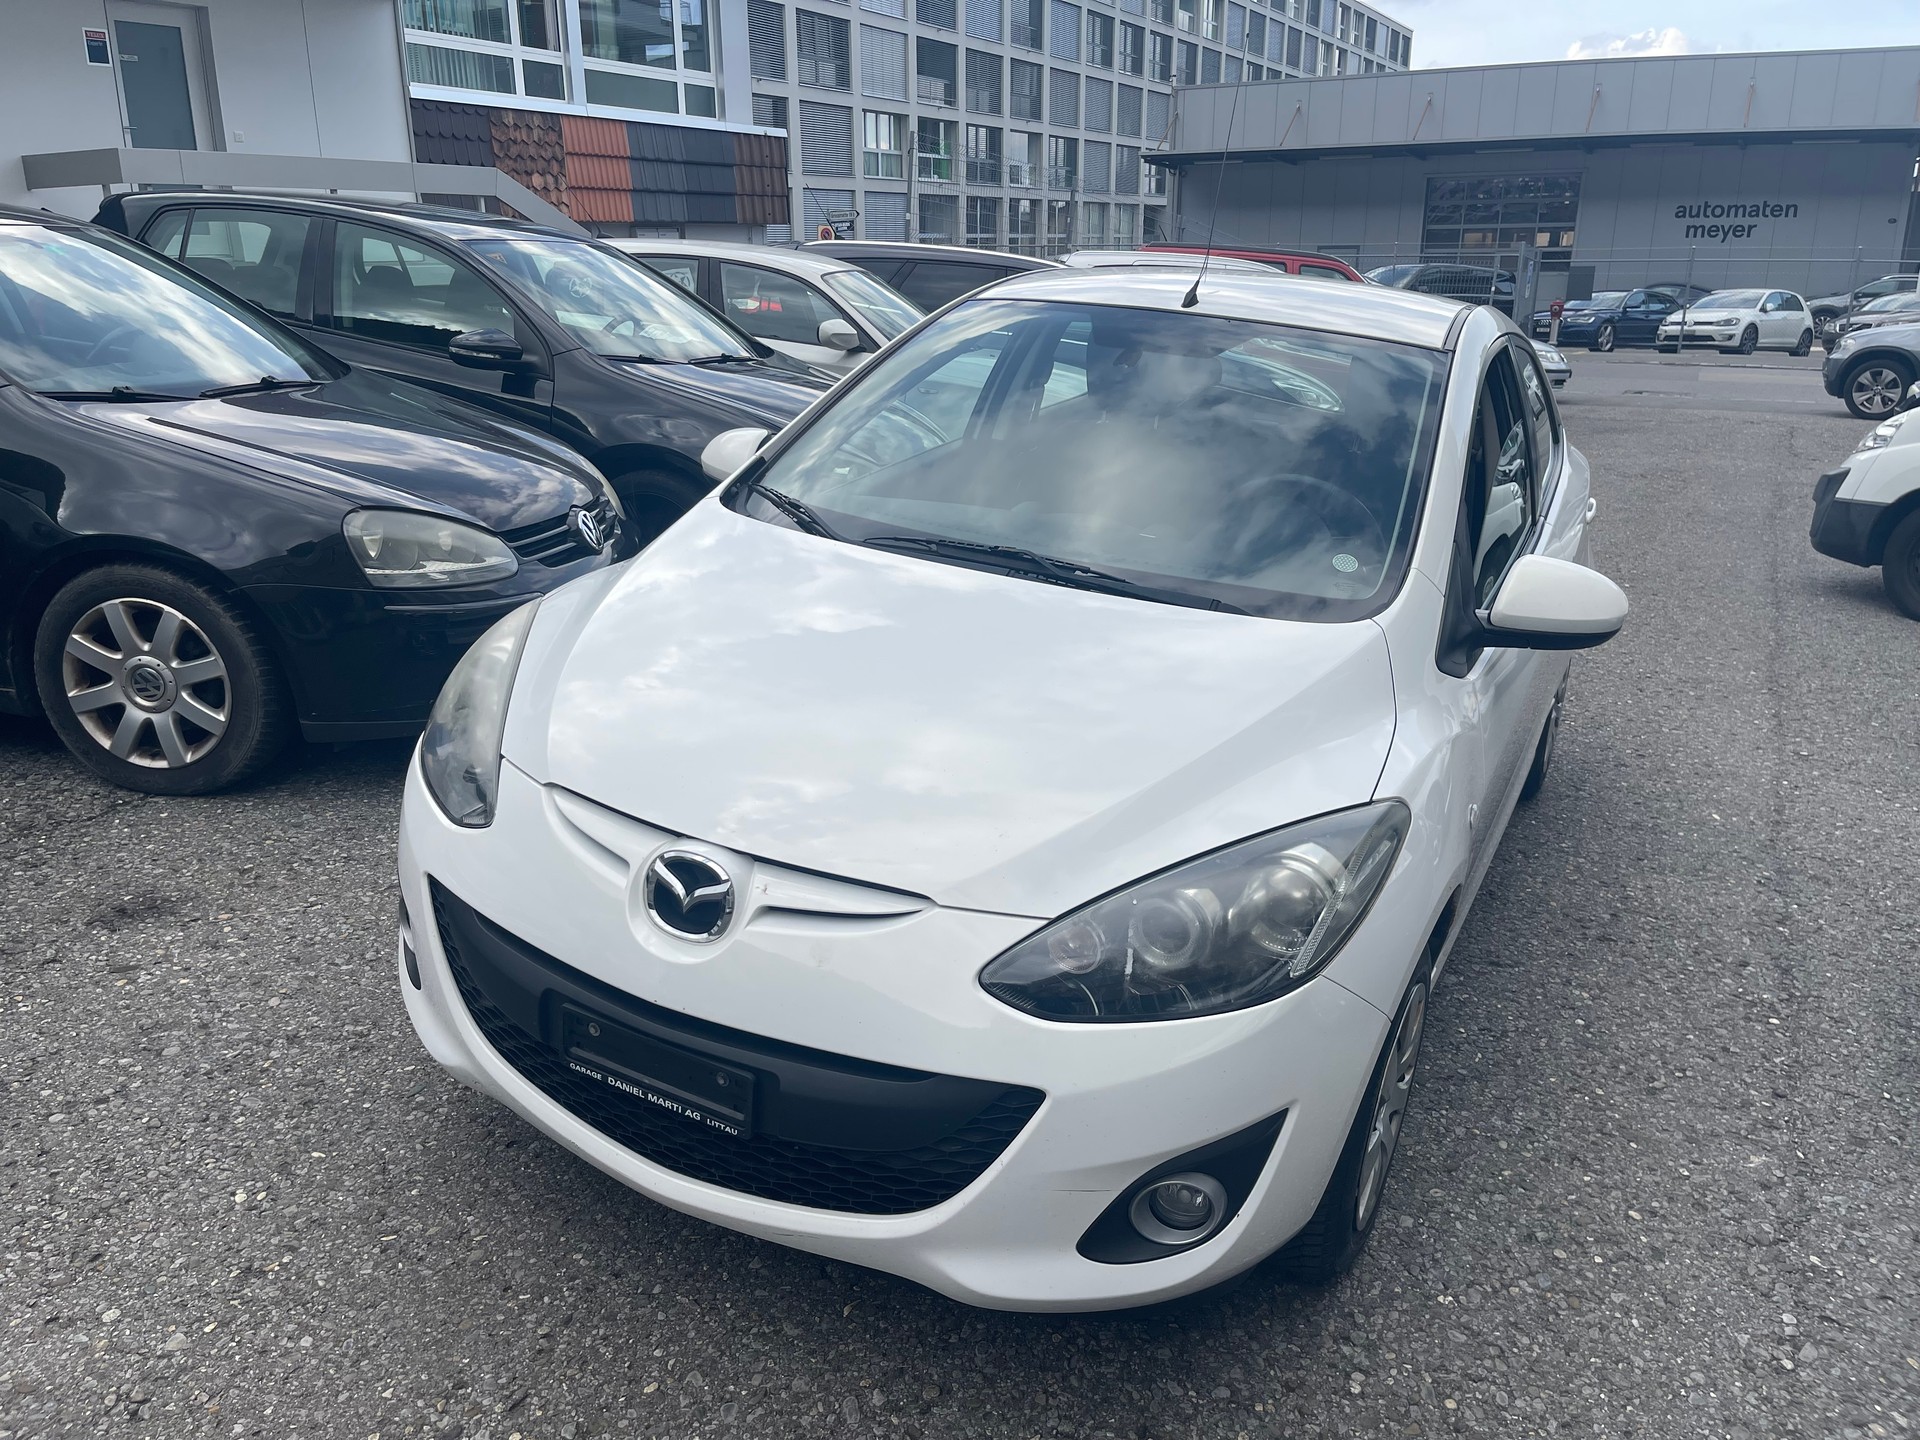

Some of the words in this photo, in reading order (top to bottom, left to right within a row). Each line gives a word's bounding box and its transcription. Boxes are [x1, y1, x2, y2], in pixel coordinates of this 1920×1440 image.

[1674, 200, 1799, 219] automaten
[1685, 224, 1757, 243] meyer
[569, 1062, 602, 1081] GARAGE
[607, 1076, 645, 1099] DANIEL
[647, 1093, 682, 1114] MARTI
[685, 1108, 701, 1121] AG
[707, 1118, 738, 1136] LITTAU
